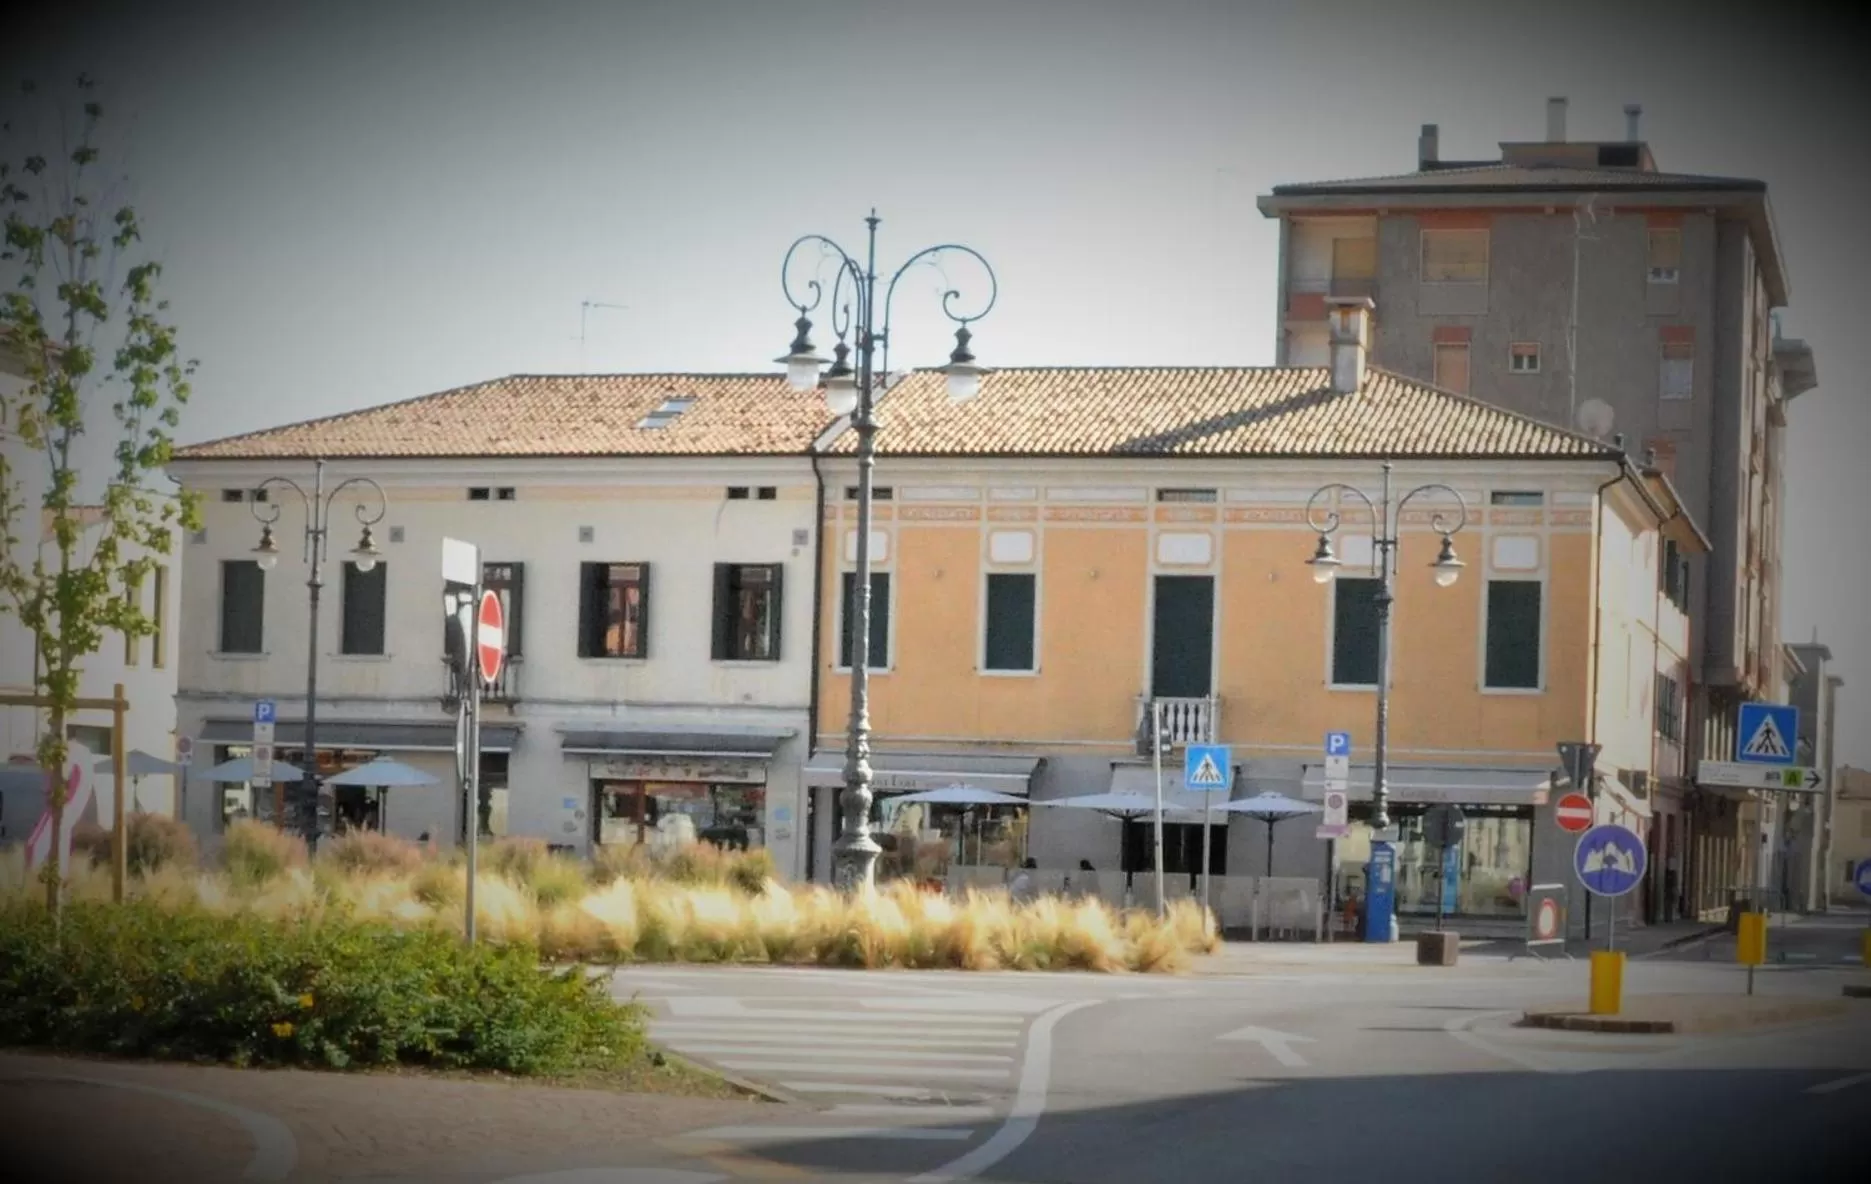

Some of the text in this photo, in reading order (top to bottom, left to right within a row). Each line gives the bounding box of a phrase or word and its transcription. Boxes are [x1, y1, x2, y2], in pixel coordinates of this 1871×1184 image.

[259, 704, 270, 721] P
[1330, 734, 1345, 753] P
[1787, 770, 1798, 785] A
